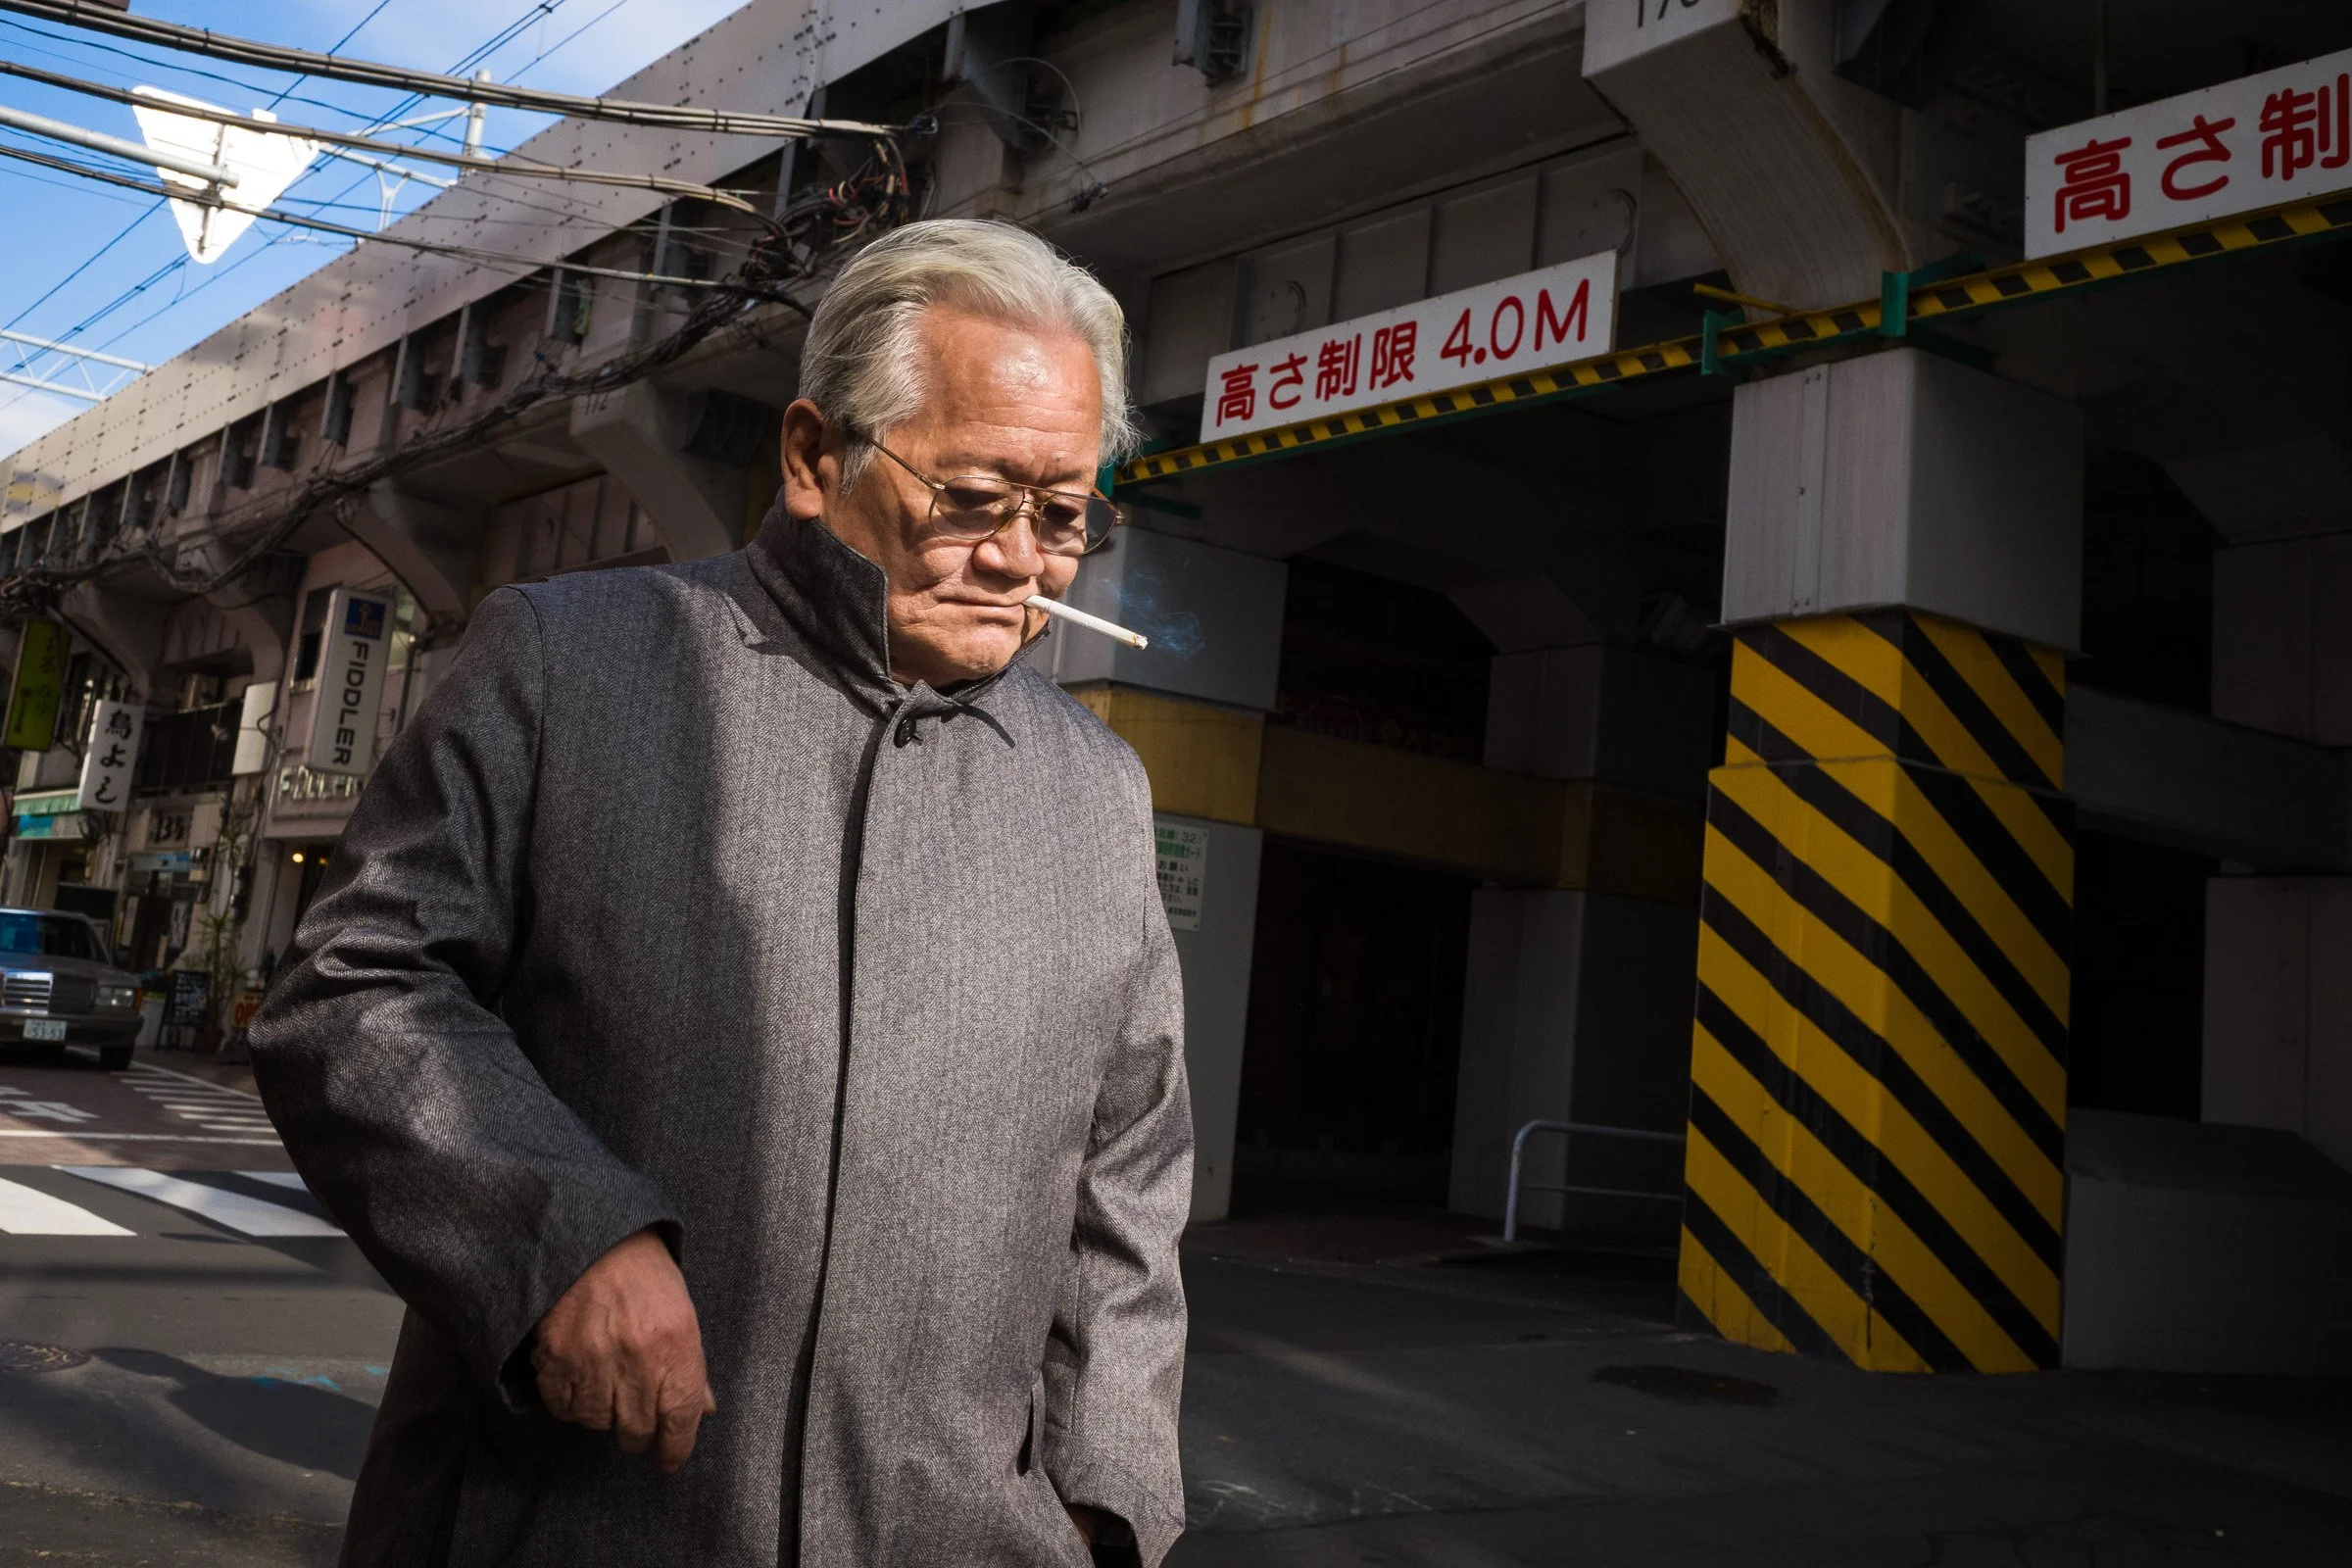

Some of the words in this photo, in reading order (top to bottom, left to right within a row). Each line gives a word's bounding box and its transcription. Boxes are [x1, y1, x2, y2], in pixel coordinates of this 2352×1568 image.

[2054, 73, 2351, 234] 高さ制
[1216, 320, 1418, 427] 高さ制限
[1440, 278, 1591, 368] 4.0M
[332, 641, 369, 765] FIDDLER
